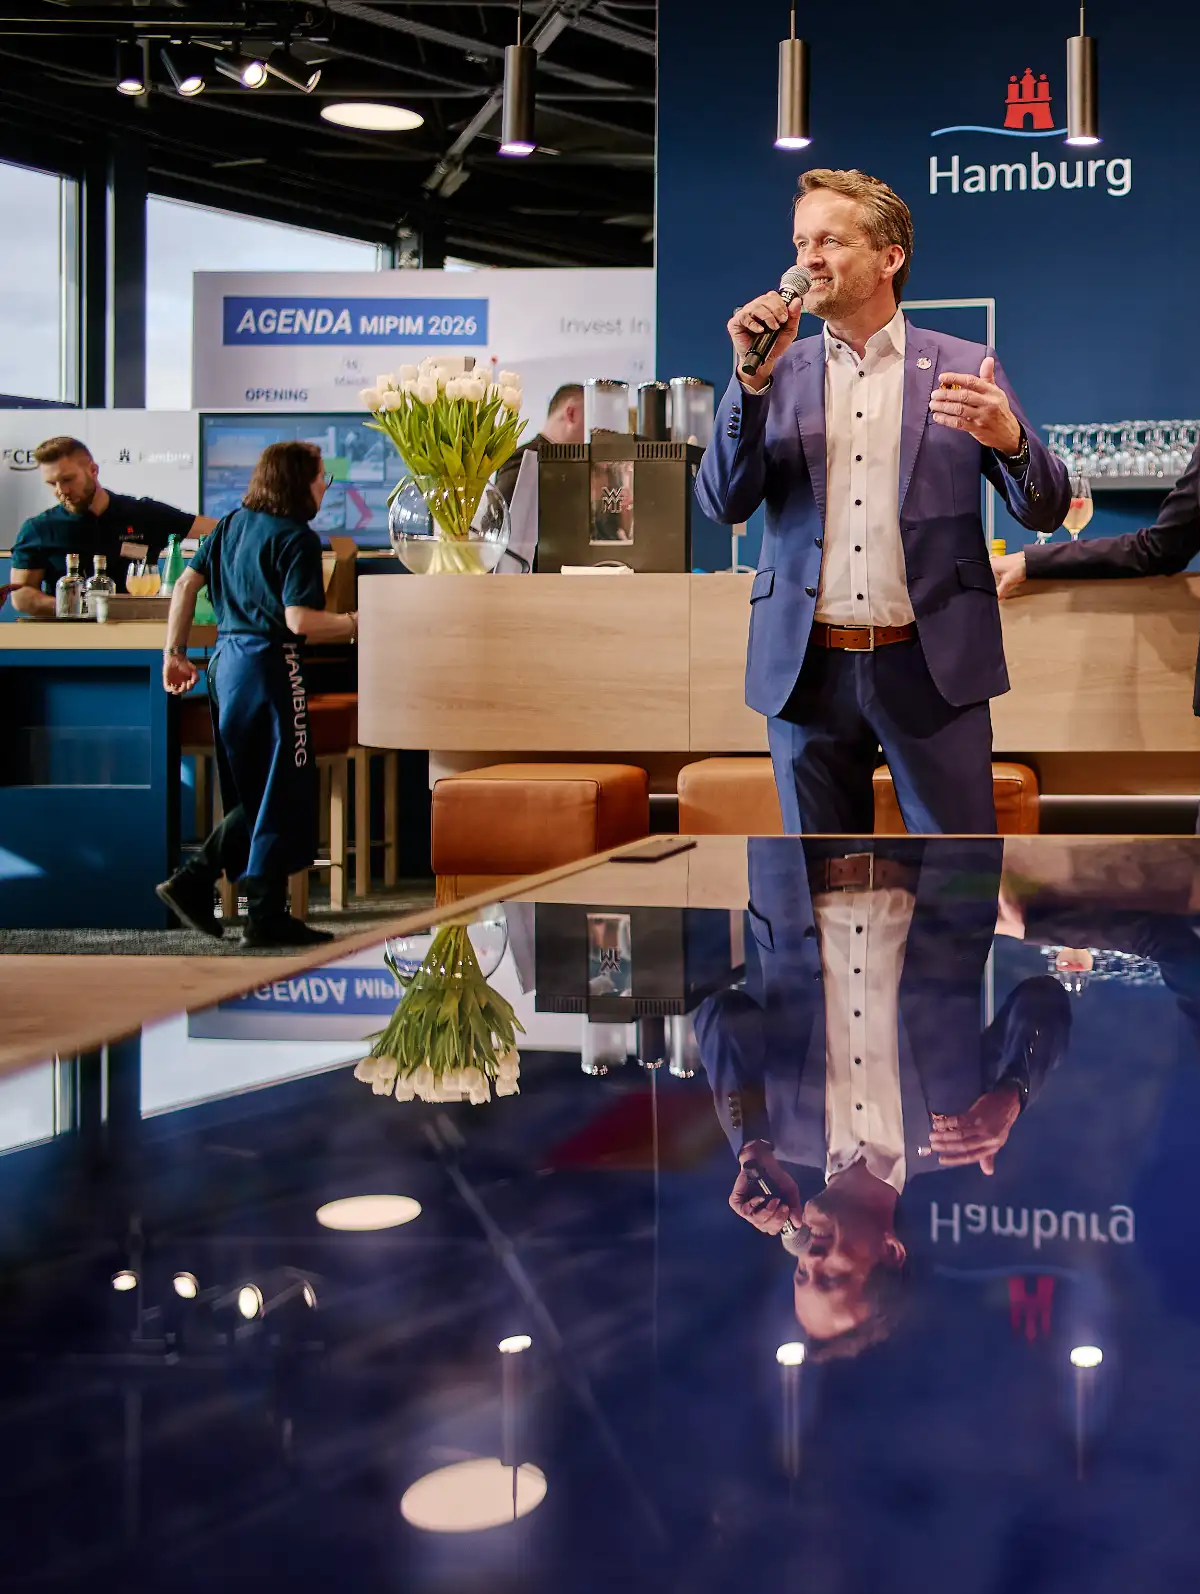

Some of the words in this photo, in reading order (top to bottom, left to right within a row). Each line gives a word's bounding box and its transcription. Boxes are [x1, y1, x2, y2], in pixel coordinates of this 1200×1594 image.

[929, 151, 1132, 197] Hamburg
[236, 308, 352, 335] AGENDA
[359, 315, 423, 335] MIPIM
[428, 315, 478, 336] 2026
[282, 642, 307, 768] HAMBURG
